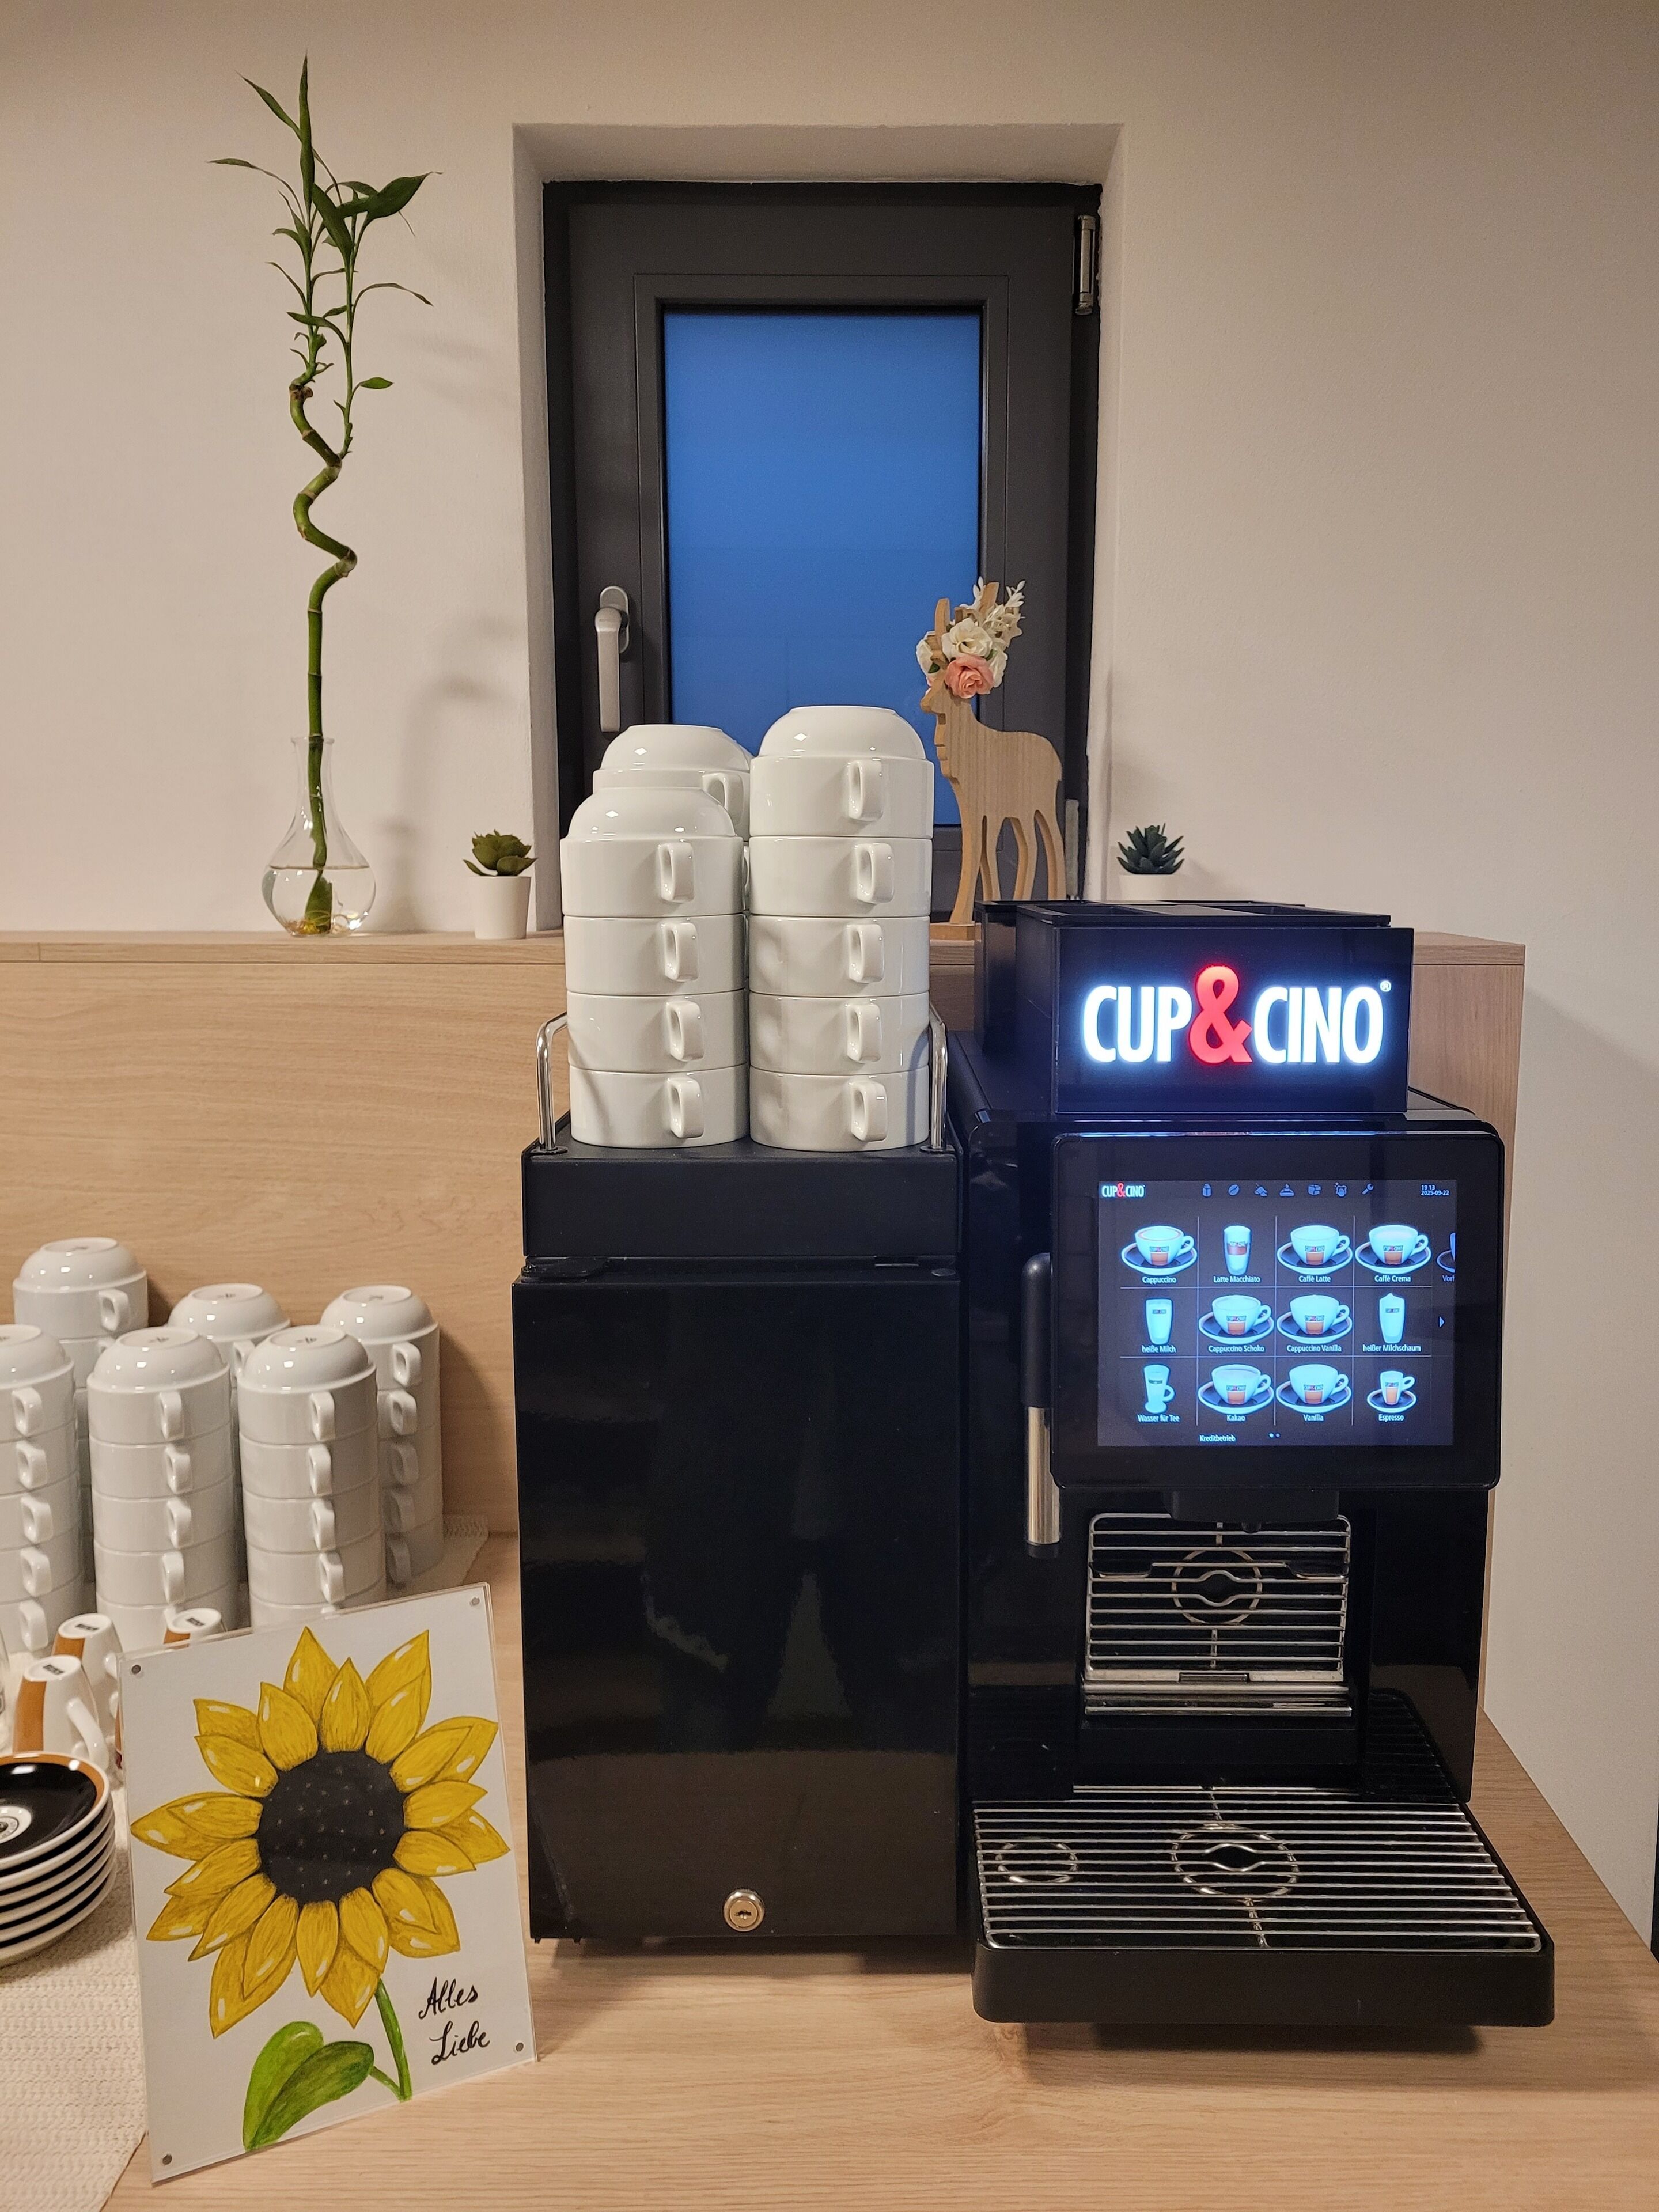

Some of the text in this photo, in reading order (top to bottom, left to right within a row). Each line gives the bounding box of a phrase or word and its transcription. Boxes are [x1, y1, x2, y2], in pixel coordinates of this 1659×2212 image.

[1142, 1276, 1176, 1285] Cappuccino
[1209, 1345, 1242, 1353] Cappuccino
[1287, 1344, 1320, 1353] Cappuccino
[1363, 1344, 1421, 1352] heißer Milchschaum
[1160, 1414, 1169, 1422] für
[1379, 1414, 1404, 1423] Espresso
[1200, 1434, 1236, 1442] Kreditbetrieb
[418, 1976, 478, 2020] Alles
[429, 2021, 490, 2065] Liebe
